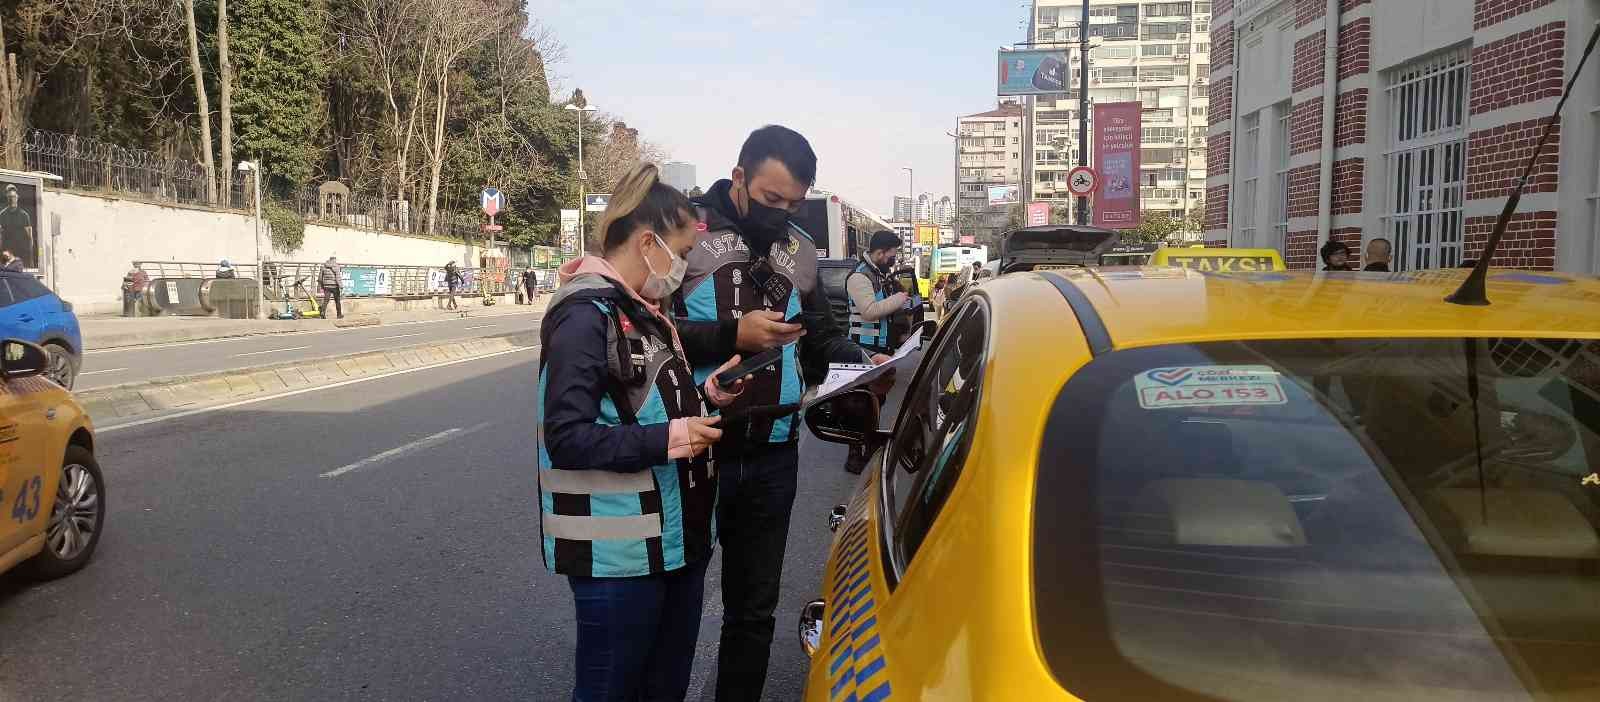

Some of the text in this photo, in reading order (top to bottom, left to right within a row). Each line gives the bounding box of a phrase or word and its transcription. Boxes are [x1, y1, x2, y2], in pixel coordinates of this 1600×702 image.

[1155, 387, 1269, 401] ALO 153
[12, 475, 42, 524] 43
